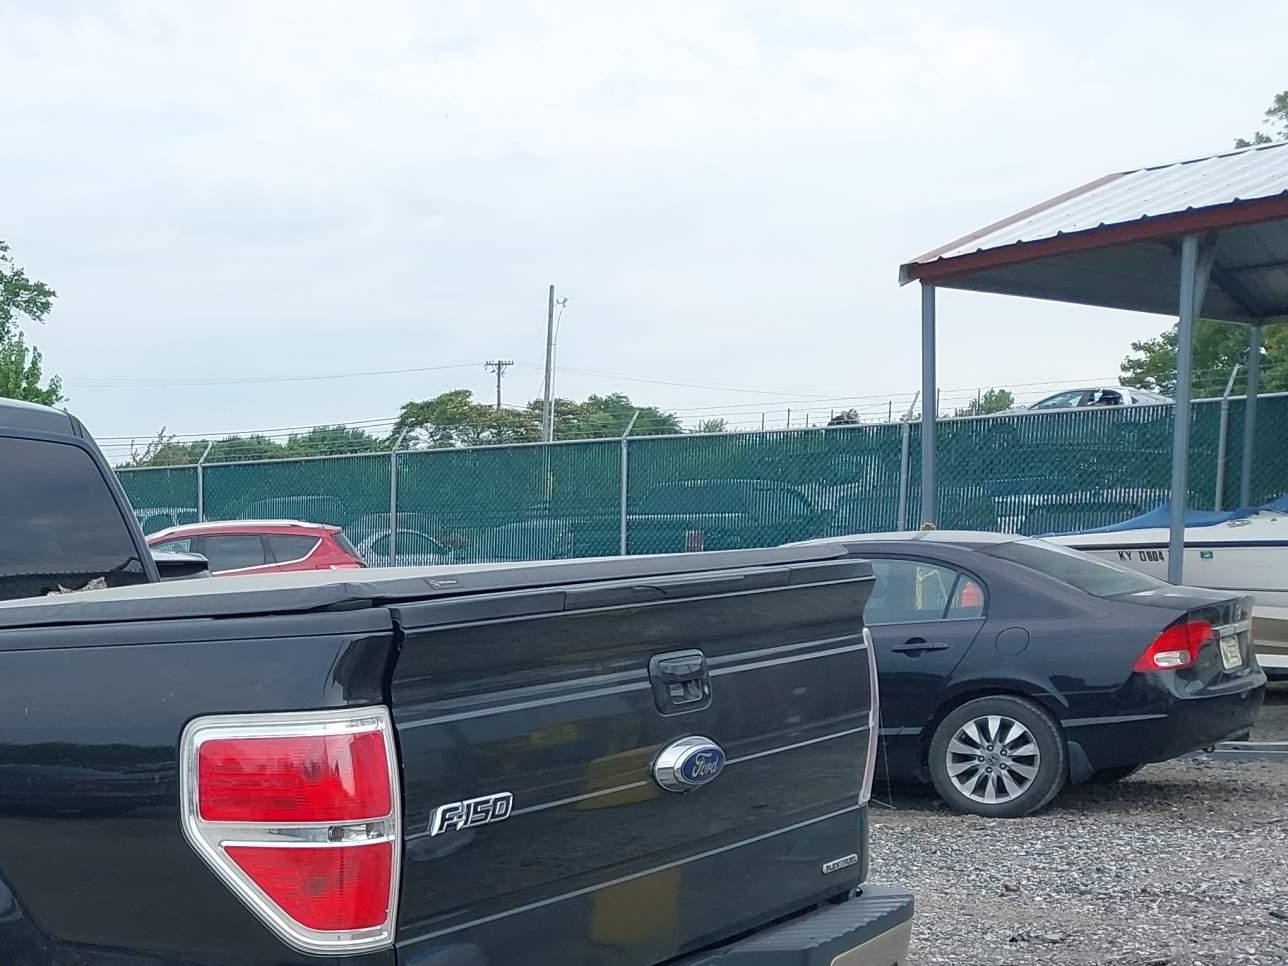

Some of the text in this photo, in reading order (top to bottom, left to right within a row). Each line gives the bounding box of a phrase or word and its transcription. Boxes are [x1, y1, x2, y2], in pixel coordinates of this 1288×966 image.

[1118, 550, 1132, 561] KY
[692, 752, 719, 778] Ford
[430, 791, 514, 837] F-150
